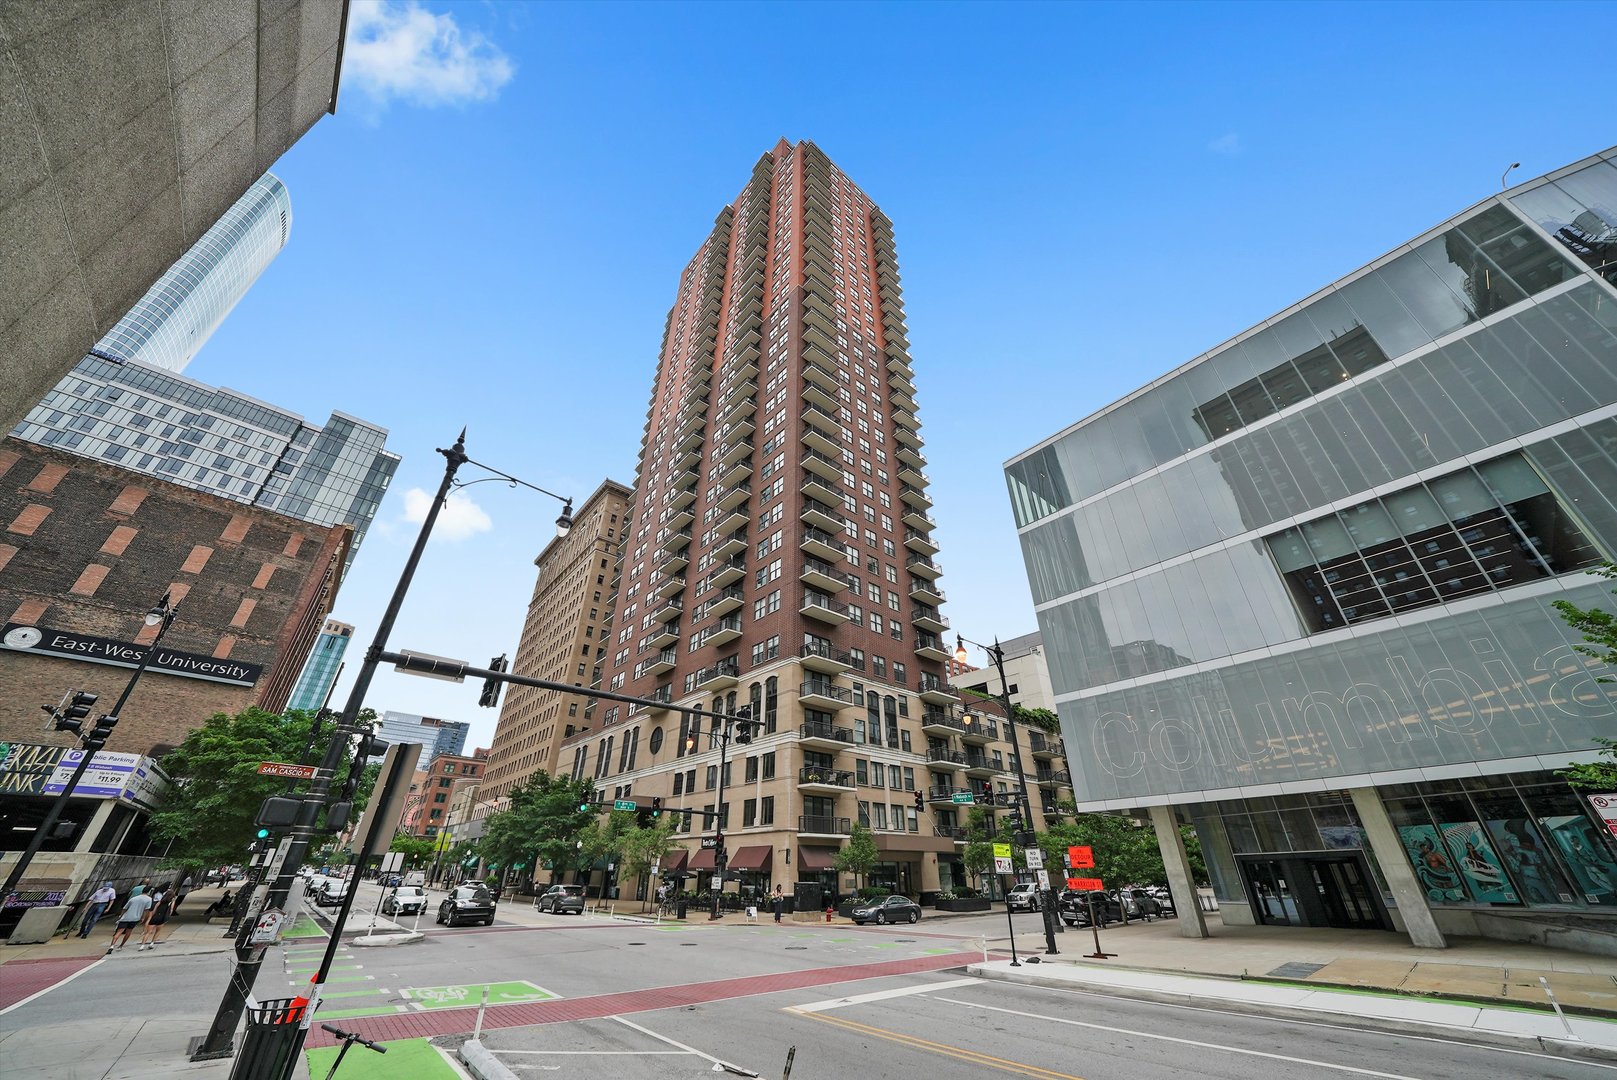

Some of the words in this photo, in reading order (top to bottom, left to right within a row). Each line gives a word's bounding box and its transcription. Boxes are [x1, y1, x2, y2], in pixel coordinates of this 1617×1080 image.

[157, 653, 250, 679] University
[1092, 638, 1617, 777] columbia
[108, 756, 135, 764] Parking
[262, 766, 277, 774] SAM
[279, 768, 303, 776] CASCIO
[98, 775, 121, 783] $11.99
